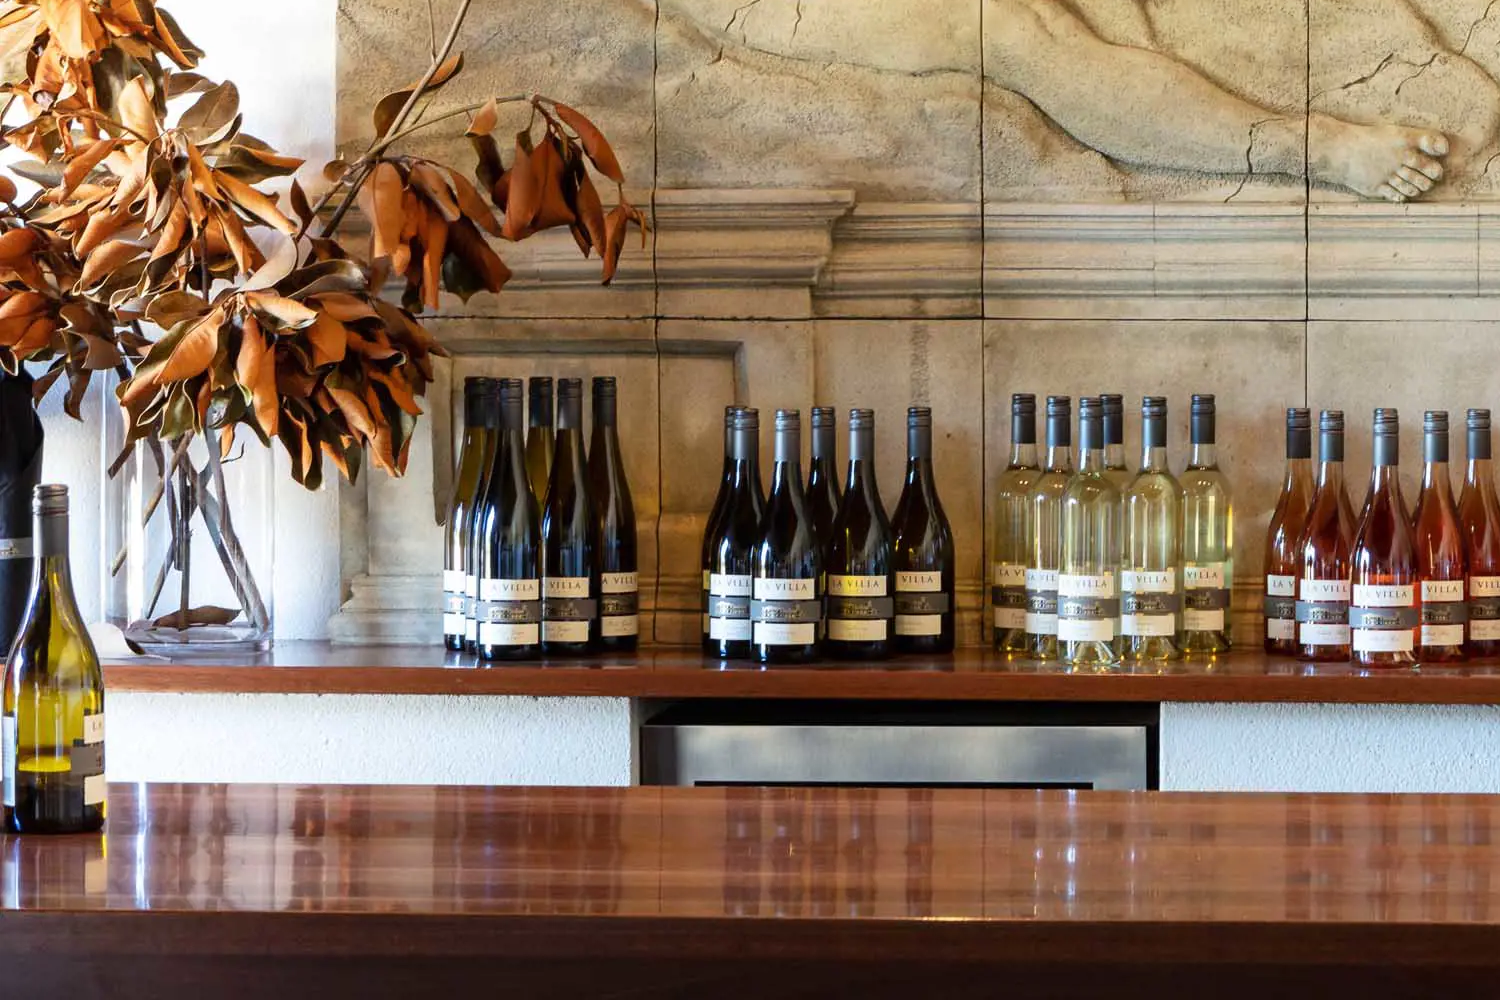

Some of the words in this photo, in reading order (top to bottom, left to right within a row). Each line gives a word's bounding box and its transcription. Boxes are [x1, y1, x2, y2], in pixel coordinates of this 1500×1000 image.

[902, 575, 933, 584] VILLA
[1136, 576, 1168, 584] VILLA
[1187, 572, 1217, 580] VILLA
[502, 583, 534, 592] VILLA
[549, 581, 581, 590] VILLA
[775, 583, 807, 591] VILLA
[847, 580, 880, 589] VILLA
[1076, 580, 1107, 588] VILLA
[1323, 585, 1348, 593] VILL
[1375, 591, 1407, 599] VILLA
